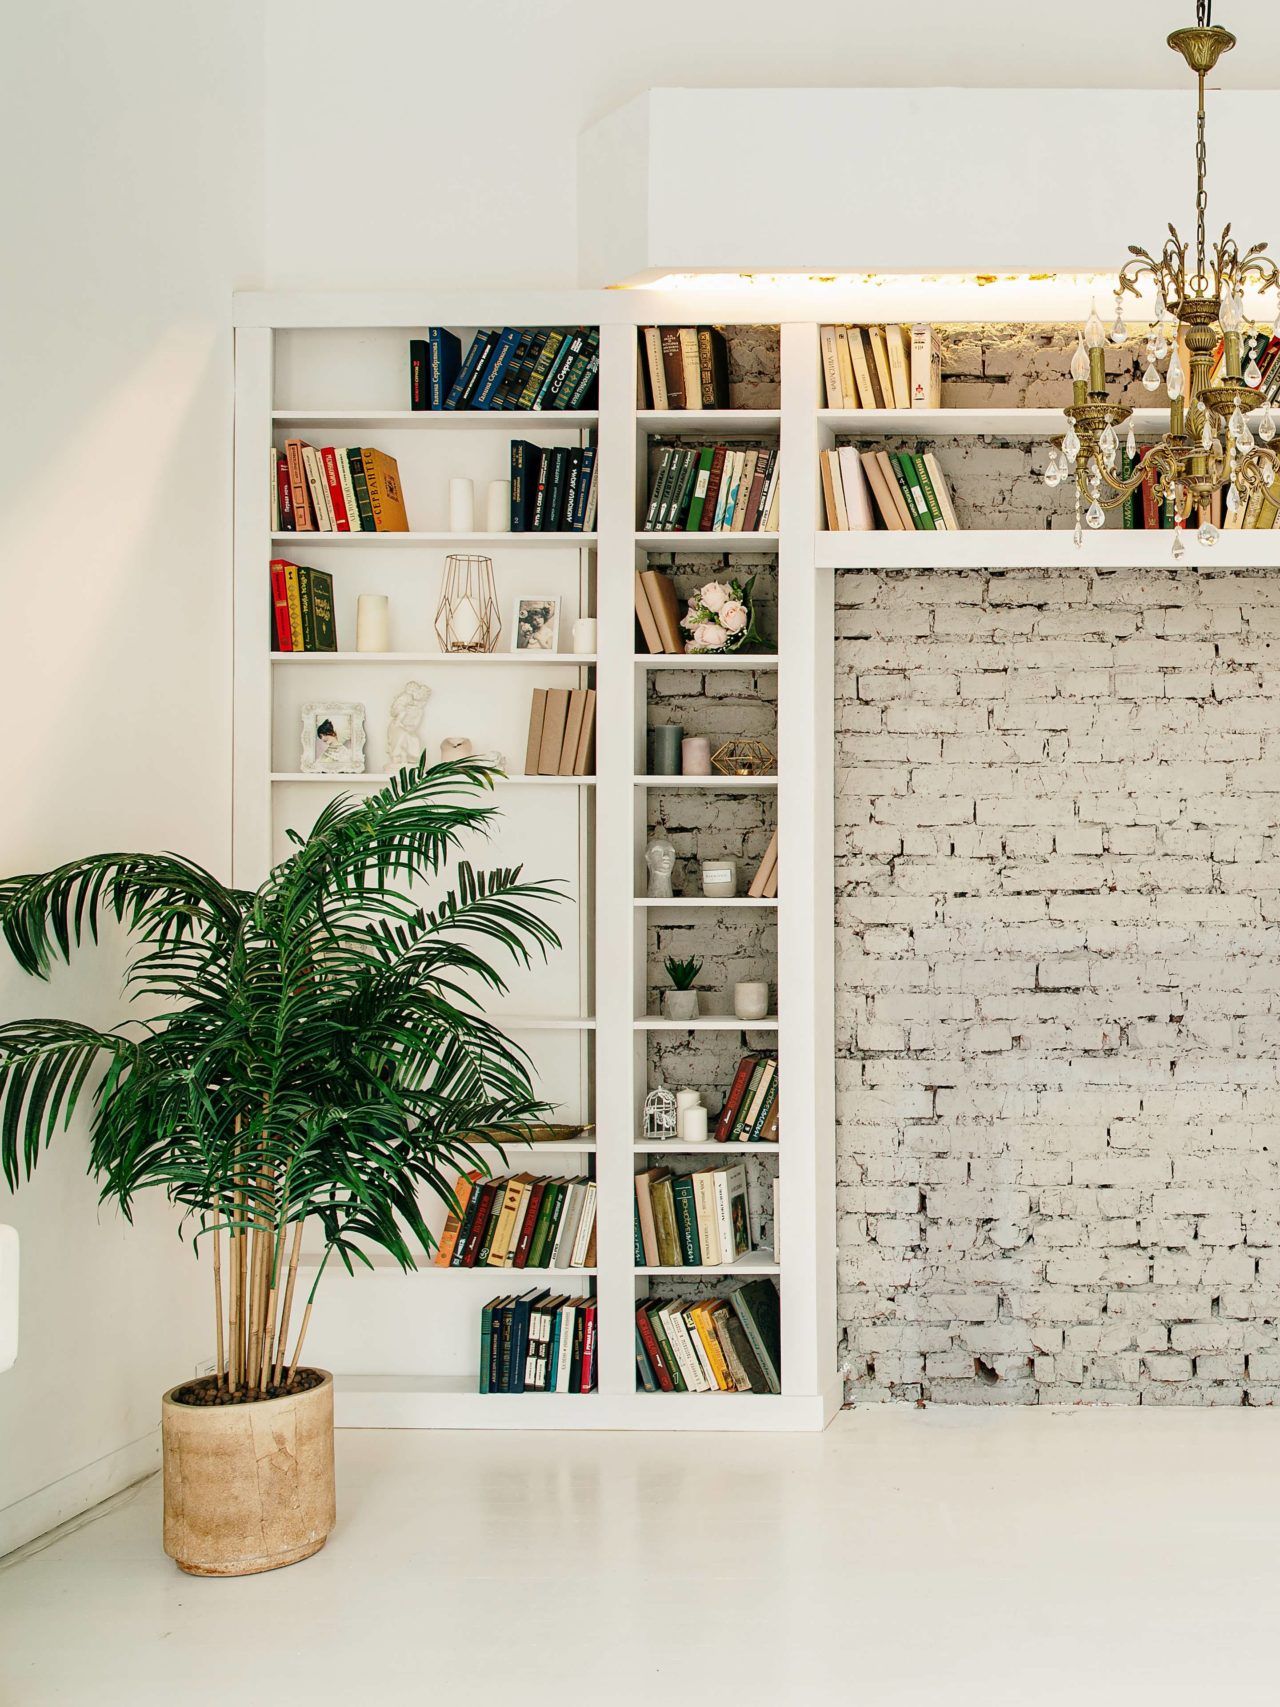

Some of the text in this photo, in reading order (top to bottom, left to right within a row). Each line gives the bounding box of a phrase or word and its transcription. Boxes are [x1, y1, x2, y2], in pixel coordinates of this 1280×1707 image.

[432, 342, 440, 382] Серебрякова
[478, 344, 510, 402] Галина Серебрякова
[364, 452, 382, 514] СЕРВАНТЕС
[566, 488, 574, 522] АЛЕКСАНДР
[916, 458, 940, 516] ДИМИТР ДИМОВ
[681, 1198, 691, 1232] ЗАДОРНОВ
